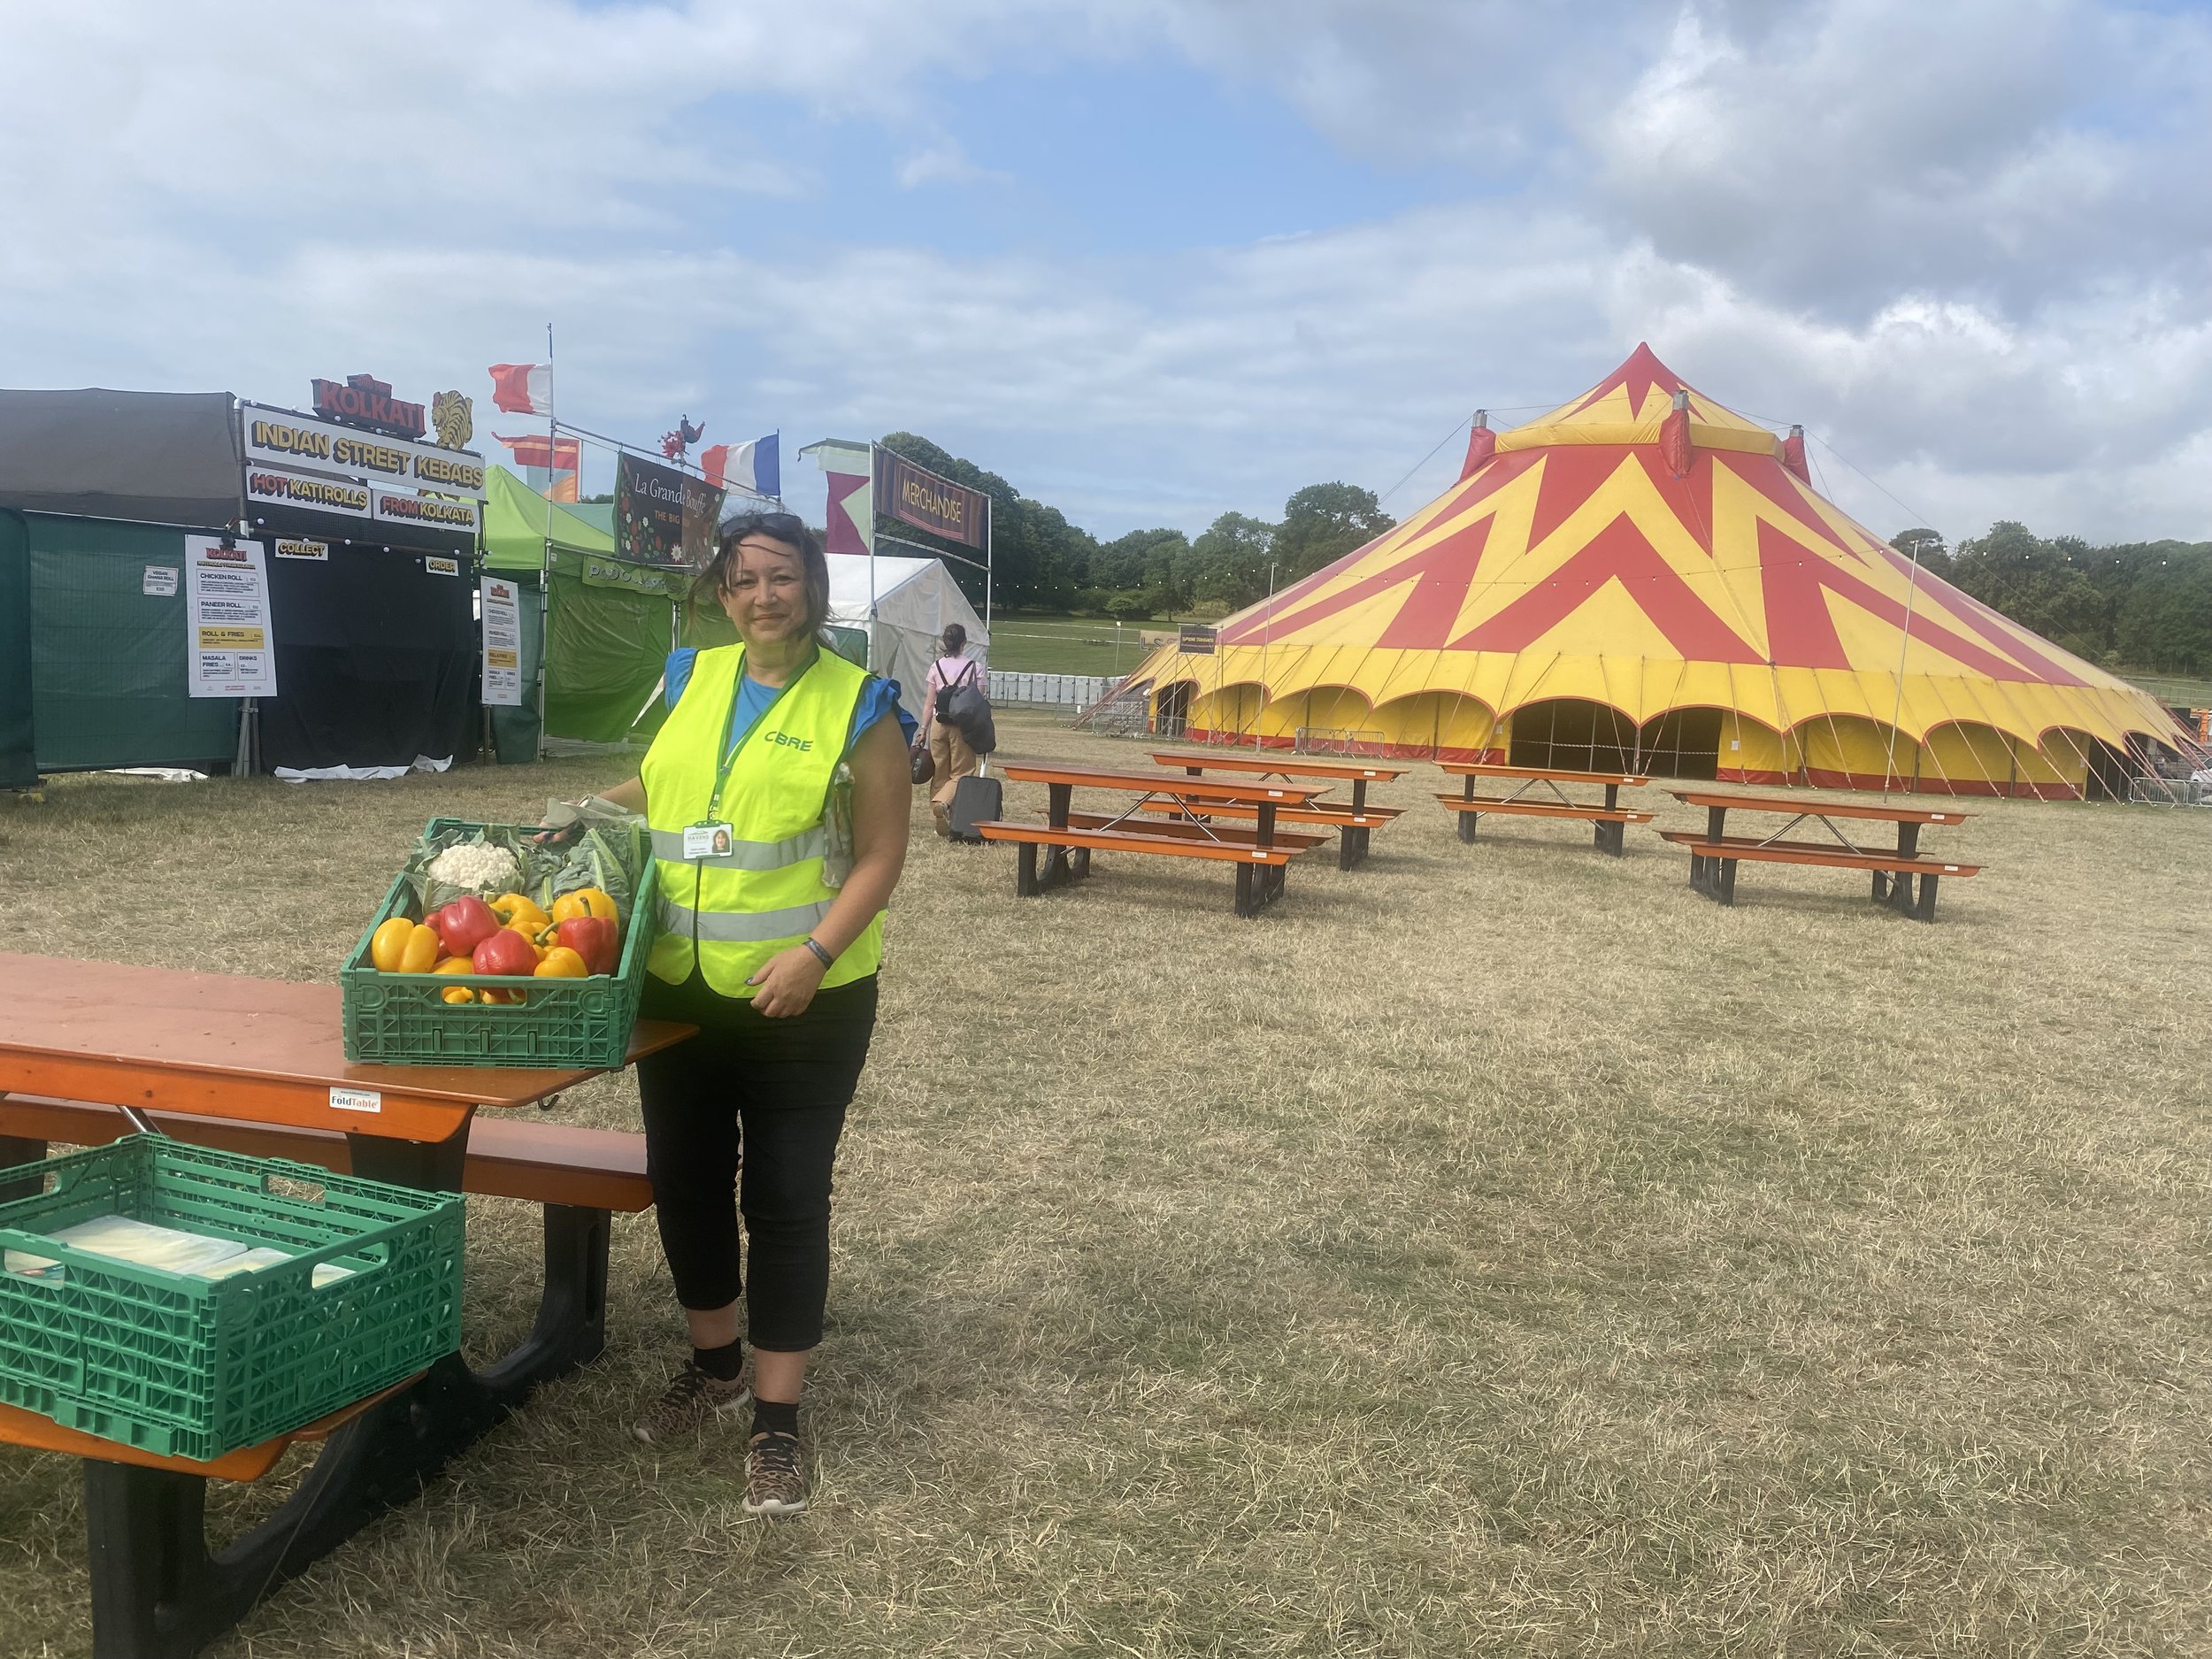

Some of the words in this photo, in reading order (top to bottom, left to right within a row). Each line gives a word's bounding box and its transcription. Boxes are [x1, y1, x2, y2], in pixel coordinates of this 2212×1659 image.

[317, 379, 425, 433] KOLKATI
[252, 420, 330, 458] INDIAN
[334, 438, 411, 474] STREET
[415, 455, 484, 489] KEBABS
[250, 473, 288, 495] HOT
[288, 479, 323, 500] KATI
[326, 485, 367, 509] ROLLS
[635, 472, 647, 495] La
[687, 488, 706, 518] Bouffe
[902, 479, 962, 523] MERCHANDISE
[380, 496, 419, 518] FROM
[419, 502, 475, 526] KOLKATA
[655, 510, 666, 521] THE
[668, 514, 680, 525] BIG
[205, 548, 247, 562] KOLKATI
[278, 542, 325, 557] COLLECT
[428, 559, 456, 572] ORDER
[764, 731, 814, 752] CBRE
[332, 1096, 378, 1109] FoldTable
